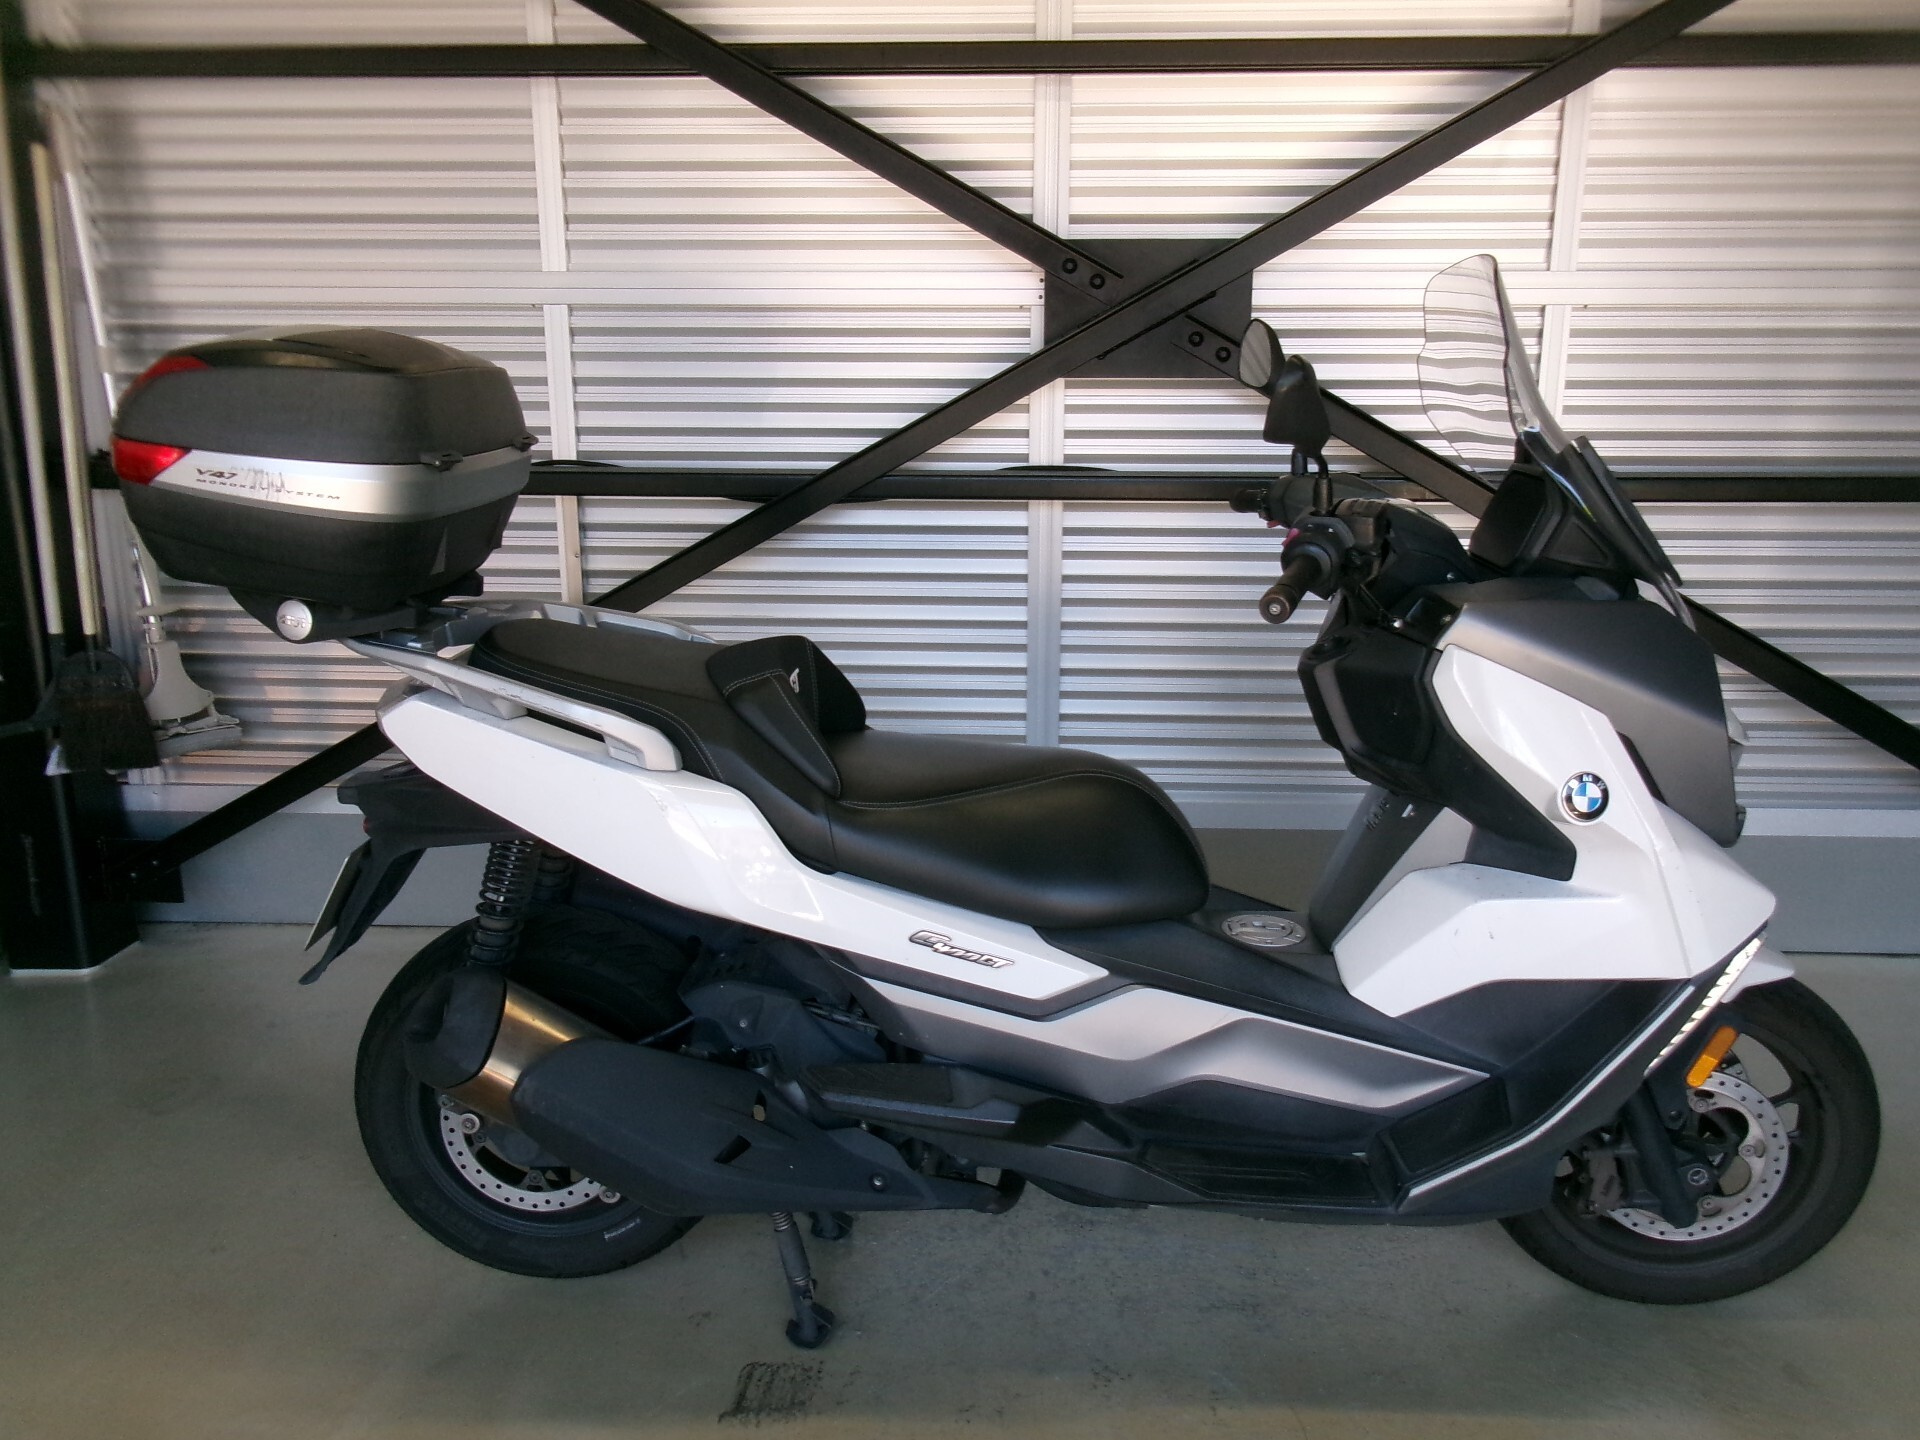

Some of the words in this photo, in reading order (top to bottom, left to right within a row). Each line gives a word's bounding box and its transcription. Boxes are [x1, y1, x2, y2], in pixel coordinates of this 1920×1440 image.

[196, 468, 238, 480] V47
[196, 478, 269, 491] MONOKEY
[275, 488, 341, 500] SYSTEM
[1568, 774, 1606, 789] BMW
